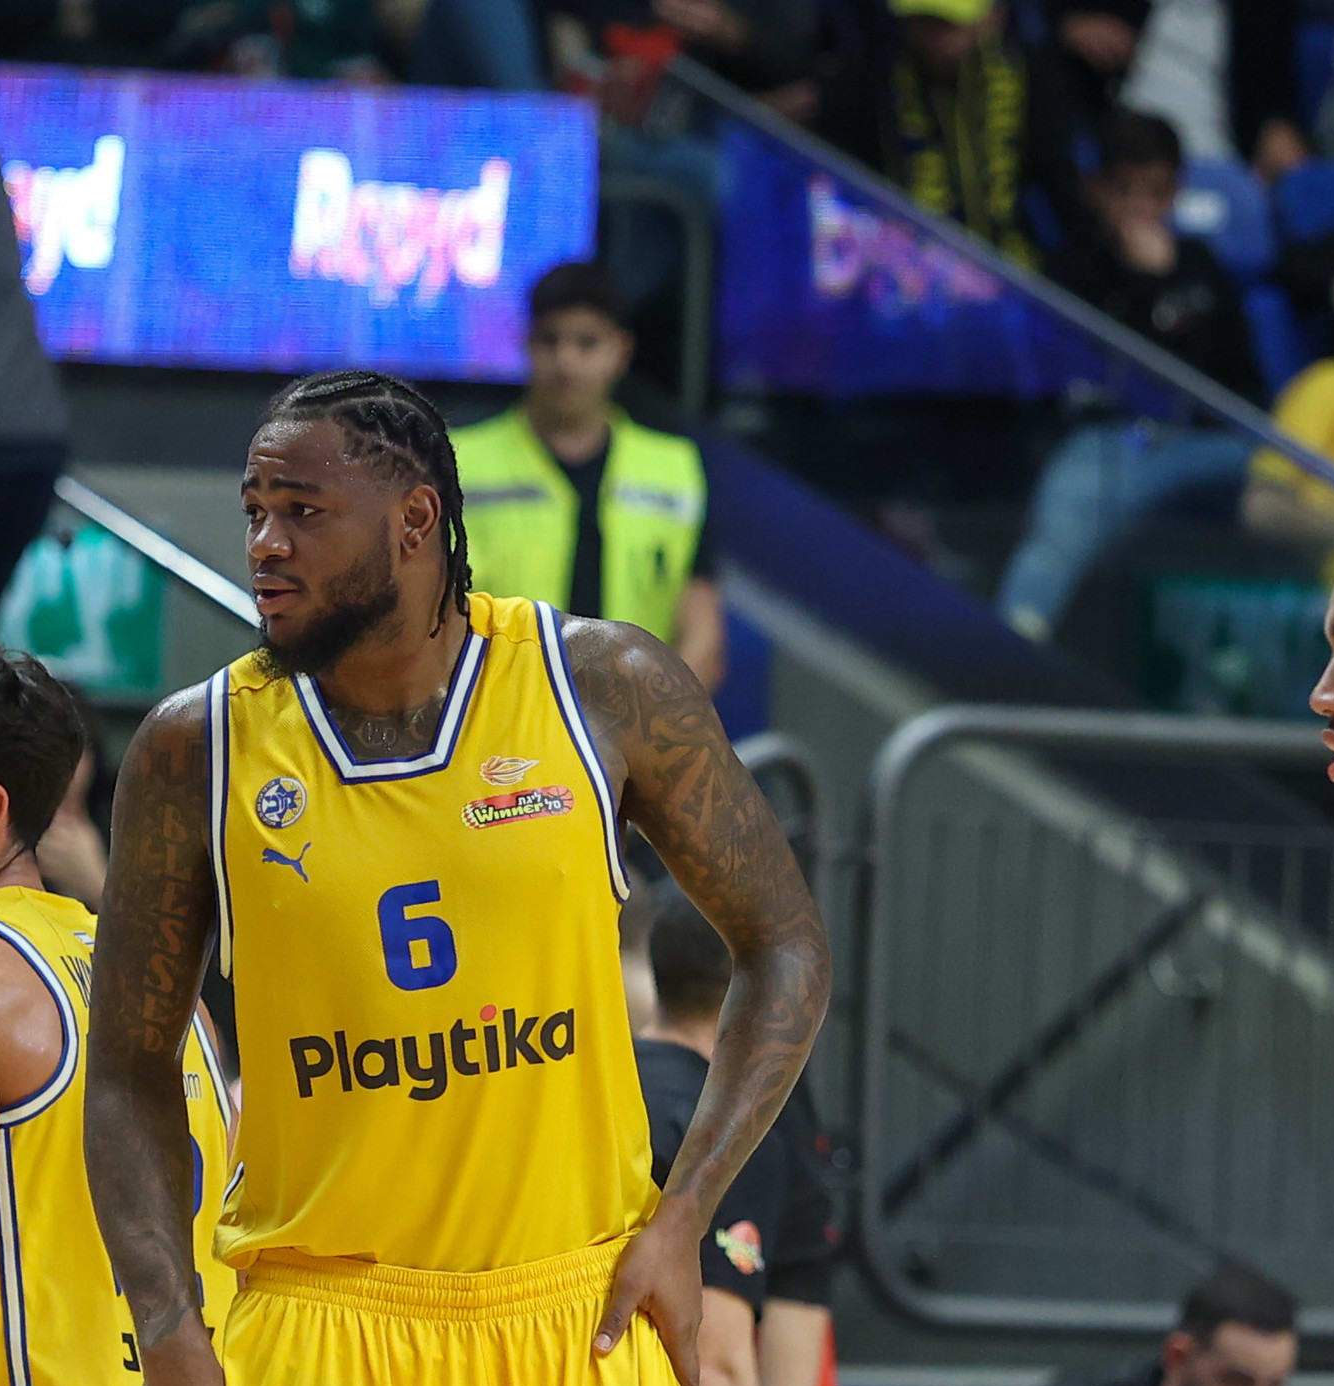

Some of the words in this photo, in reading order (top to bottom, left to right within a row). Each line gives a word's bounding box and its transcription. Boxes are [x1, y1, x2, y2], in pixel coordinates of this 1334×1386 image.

[473, 803, 544, 824] Winner
[377, 880, 457, 991] 6
[289, 1004, 576, 1101] Playtika
